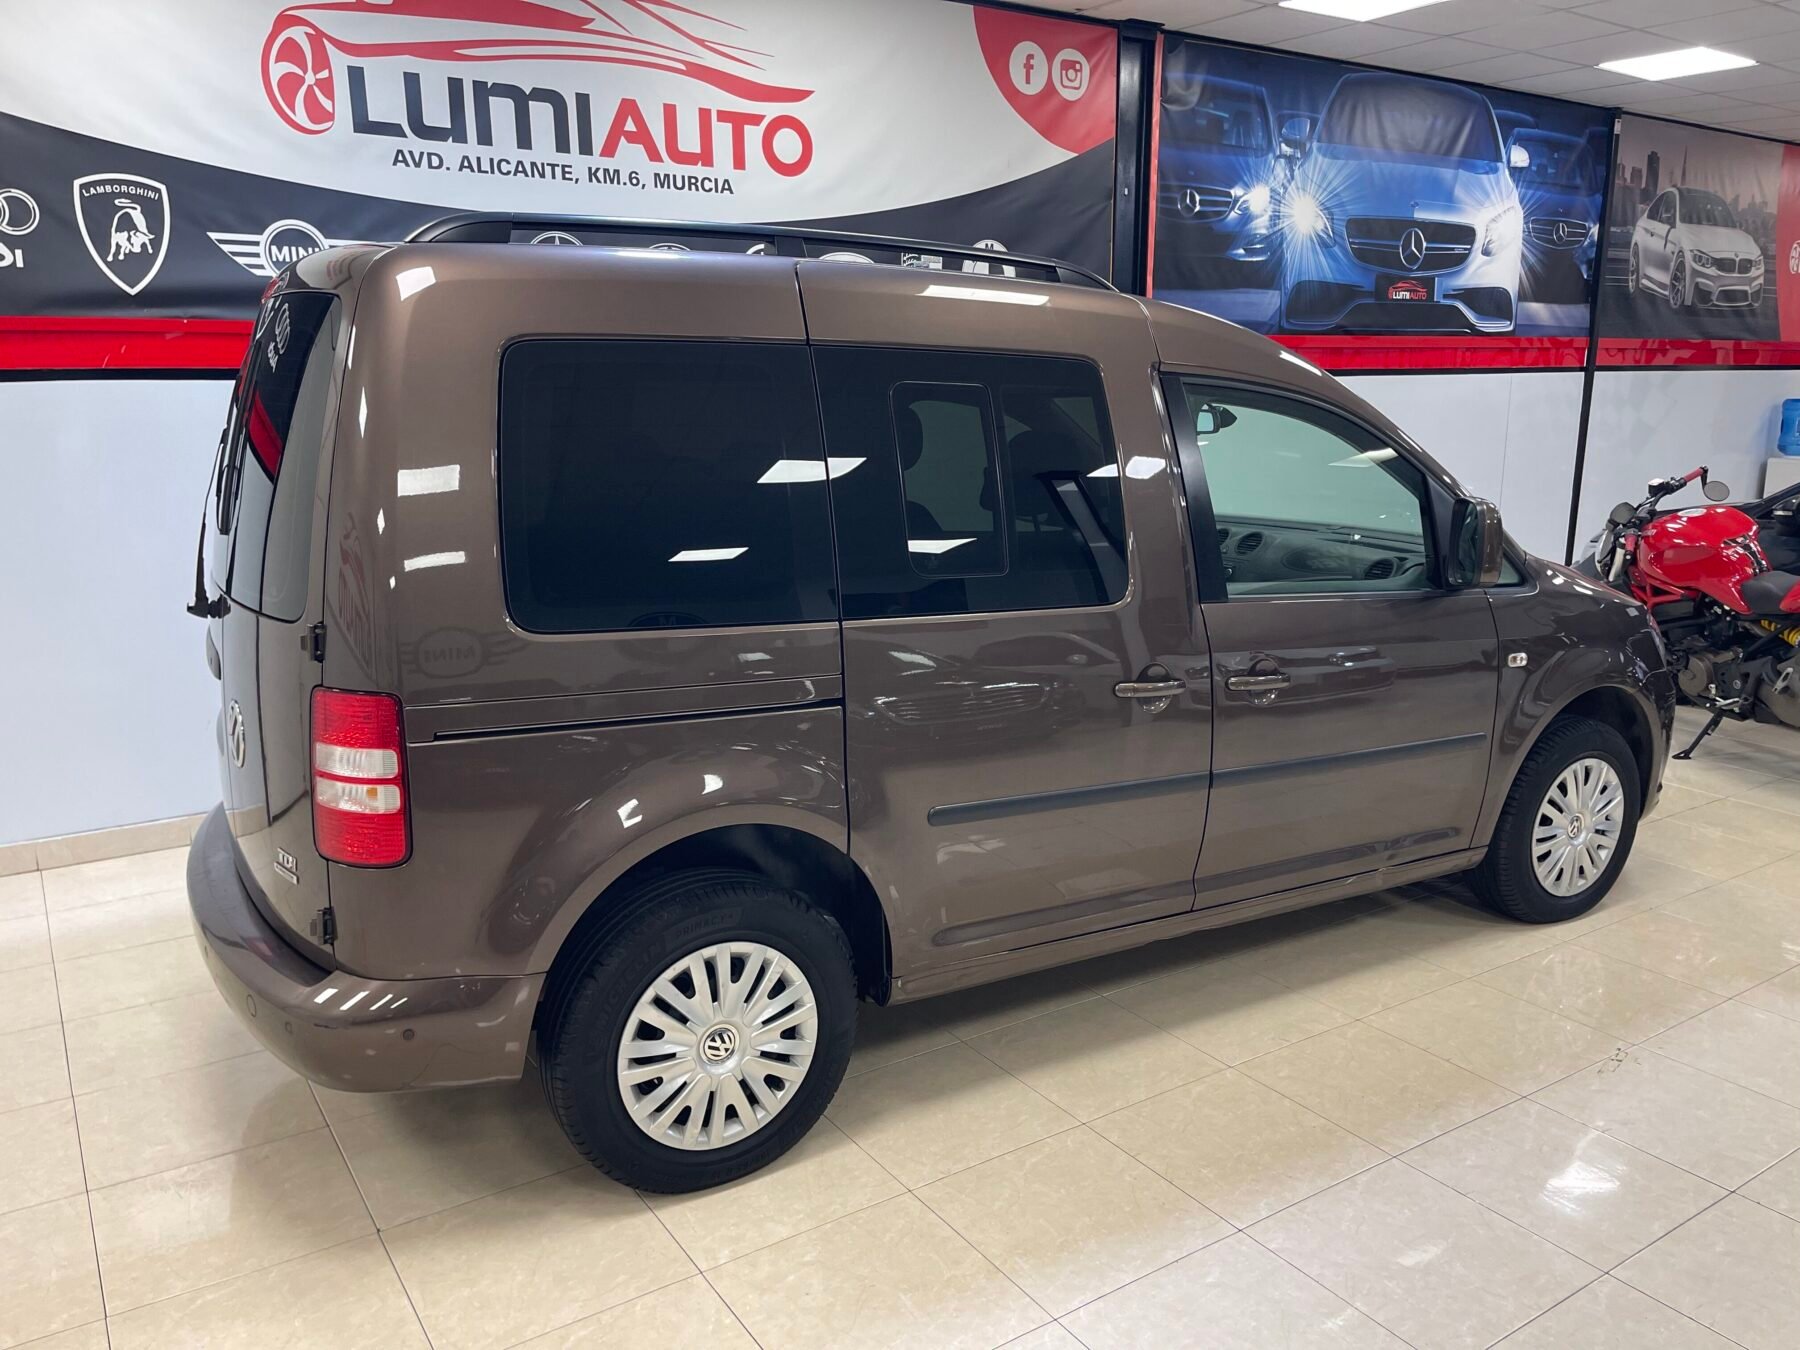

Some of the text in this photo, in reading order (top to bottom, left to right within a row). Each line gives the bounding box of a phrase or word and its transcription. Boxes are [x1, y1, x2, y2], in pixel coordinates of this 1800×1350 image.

[391, 149, 734, 195] AVD. ALICANTE, KM.6, MURCIA
[82, 184, 159, 201] LAMBORGHINI
[270, 245, 320, 263] MIN
